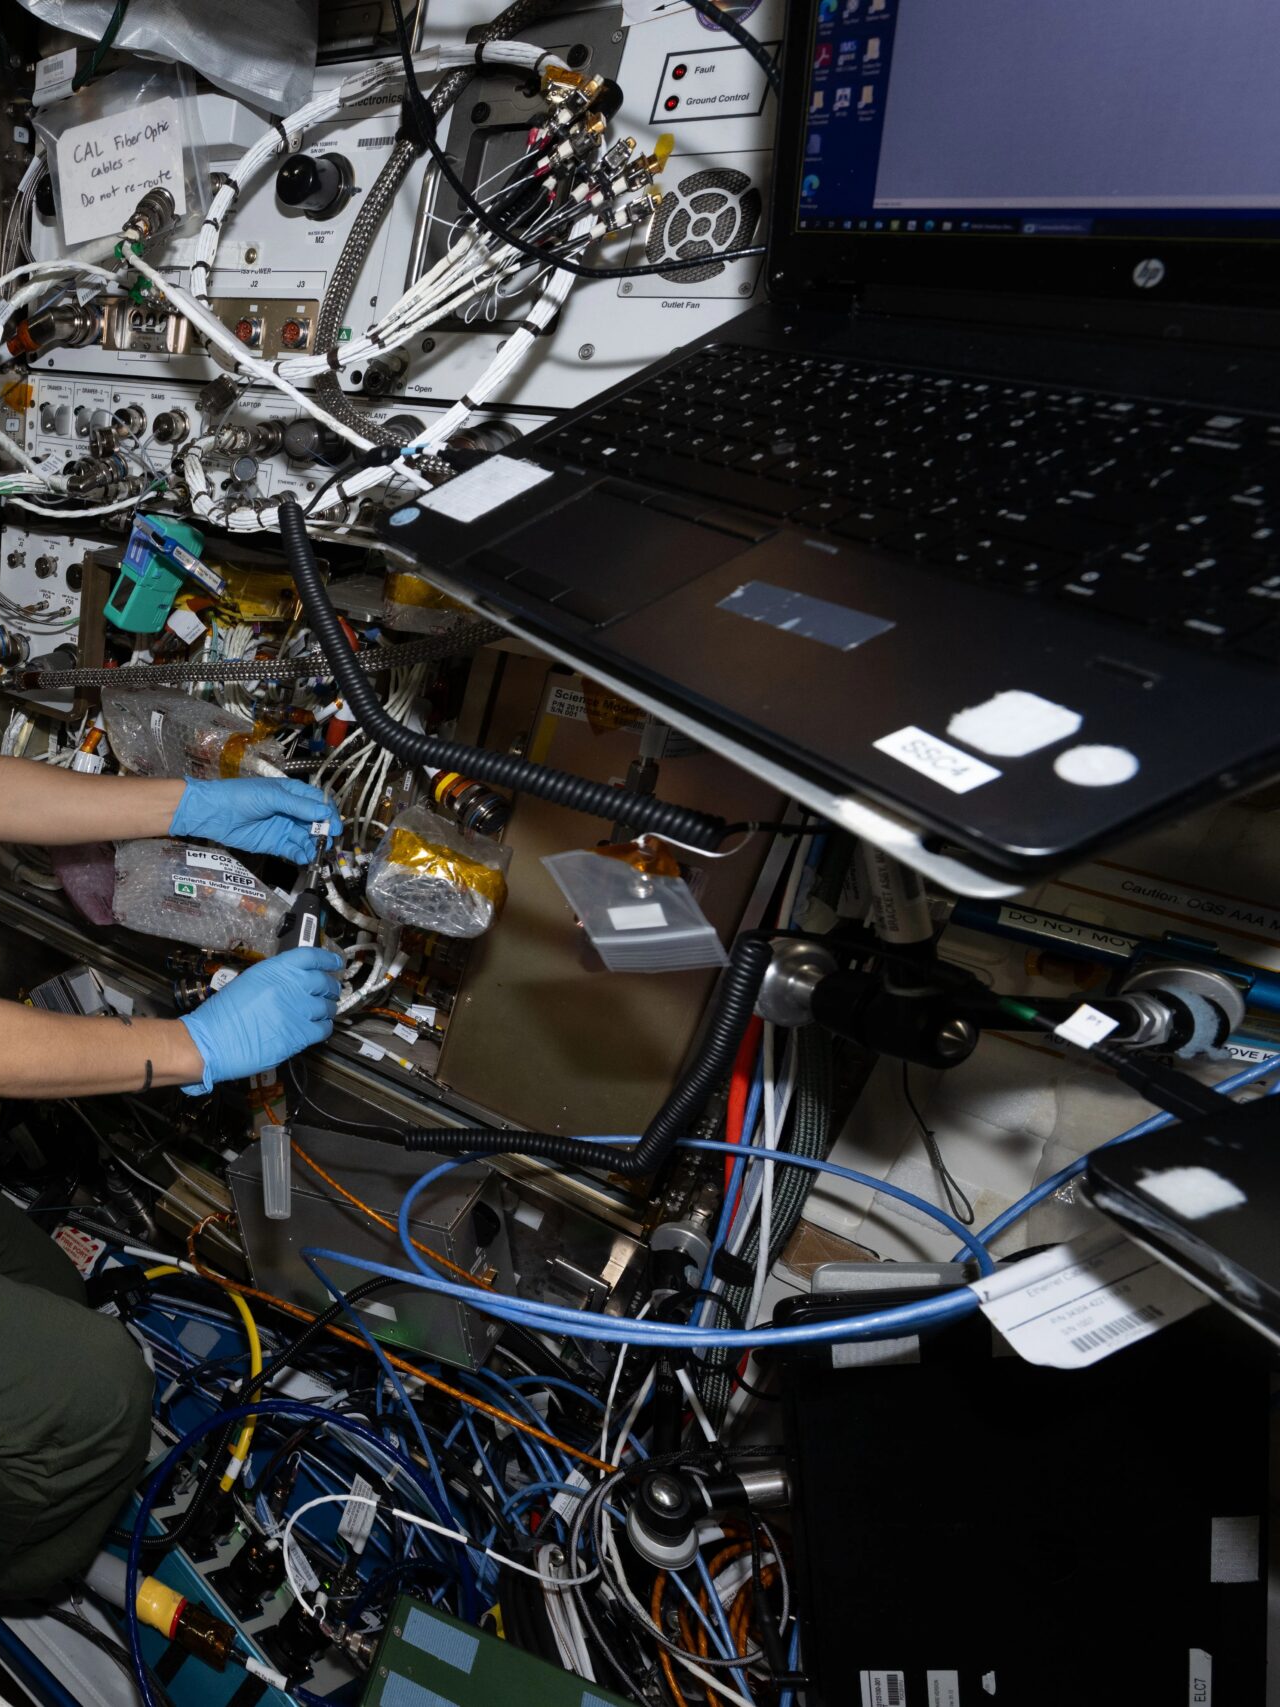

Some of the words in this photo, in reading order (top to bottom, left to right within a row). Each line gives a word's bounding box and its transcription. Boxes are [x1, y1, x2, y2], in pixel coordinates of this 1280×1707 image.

[694, 65, 715, 74] Fault
[686, 95, 718, 106] Ground
[720, 92, 750, 104] Control
[73, 140, 104, 164] CAL
[114, 131, 143, 151] Fiber
[144, 119, 170, 142] Optic
[91, 157, 124, 178] cables
[81, 193, 95, 208] Do
[100, 184, 120, 202] not
[124, 169, 172, 195] re-route
[315, 236, 325, 244] M2
[661, 300, 684, 310] Outlet
[686, 301, 700, 310] Fan
[554, 689, 600, 707] Science
[550, 706, 564, 714] S/N
[564, 710, 578, 718] 001
[188, 851, 206, 859] Left
[211, 854, 232, 864] CO2
[174, 875, 206, 885] Contents
[209, 882, 230, 890] Under
[234, 886, 265, 898] Pressure
[225, 874, 253, 886] KEEP
[884, 892, 899, 932] BRACKET
[1121, 880, 1180, 904] Caution:
[1186, 899, 1225, 916] OGS
[1230, 908, 1266, 926] AAA
[1008, 910, 1038, 925] DO
[1043, 919, 1083, 937] NOT
[1092, 930, 1138, 950] MOV
[1086, 1014, 1103, 1026] P1
[1226, 1046, 1258, 1060] OVE
[60, 1236, 73, 1248] FIRE
[72, 1245, 88, 1258] PORT
[1194, 1678, 1207, 1702] ELC7
